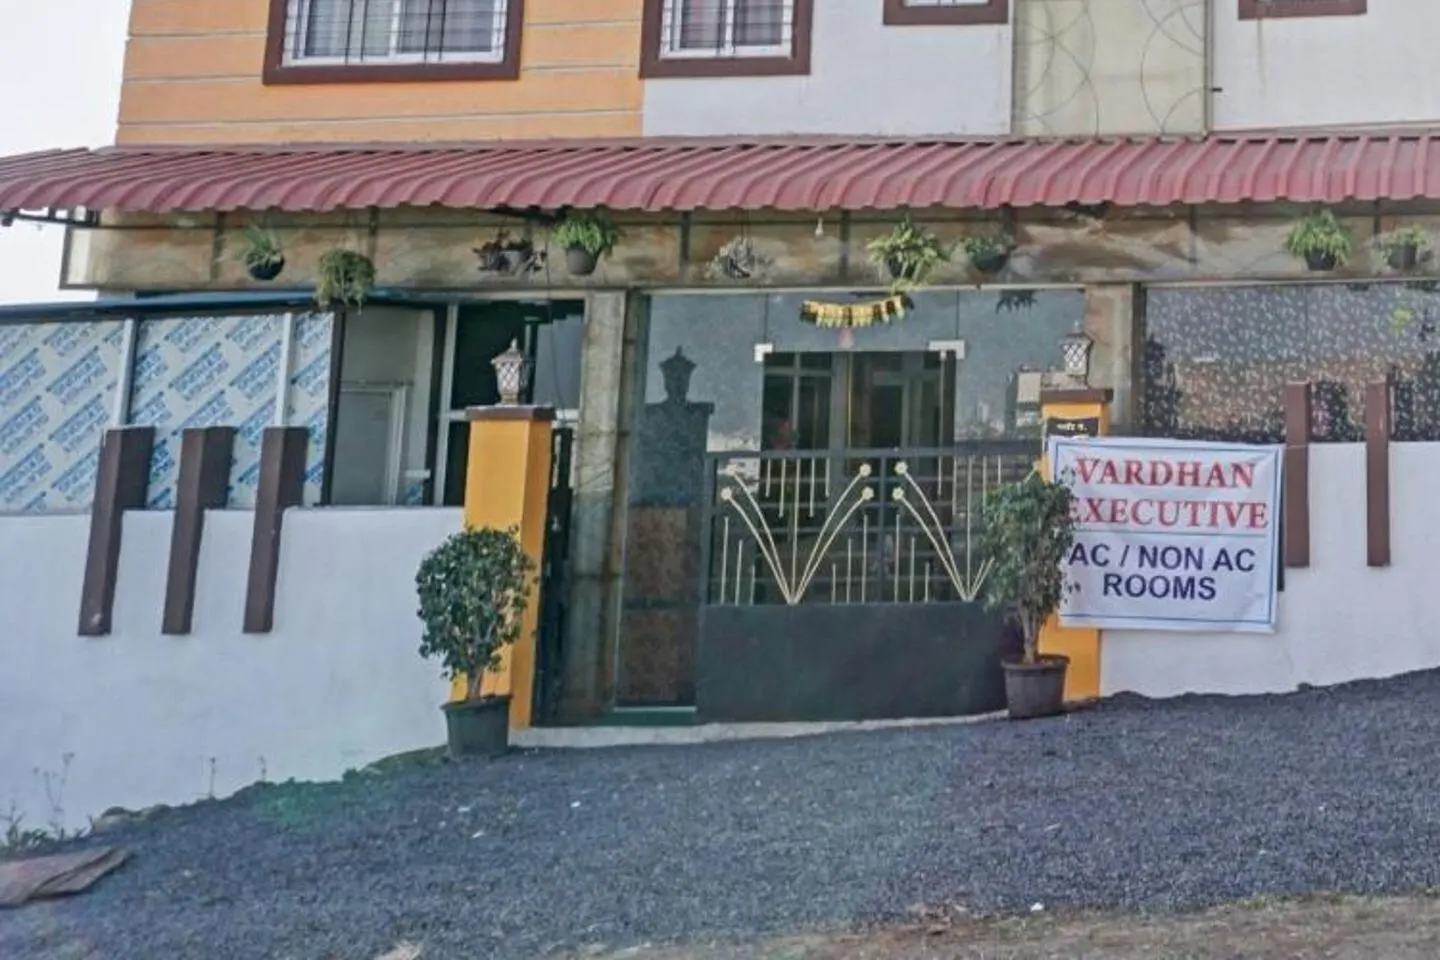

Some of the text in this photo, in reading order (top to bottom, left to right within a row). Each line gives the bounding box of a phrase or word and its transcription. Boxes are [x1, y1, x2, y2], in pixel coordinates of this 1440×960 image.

[1075, 458, 1256, 488] VARDHAN
[1068, 543, 1110, 568] AC
[1138, 546, 1203, 571] NON
[1212, 548, 1256, 573] AC
[1102, 574, 1217, 601] ROOMS
